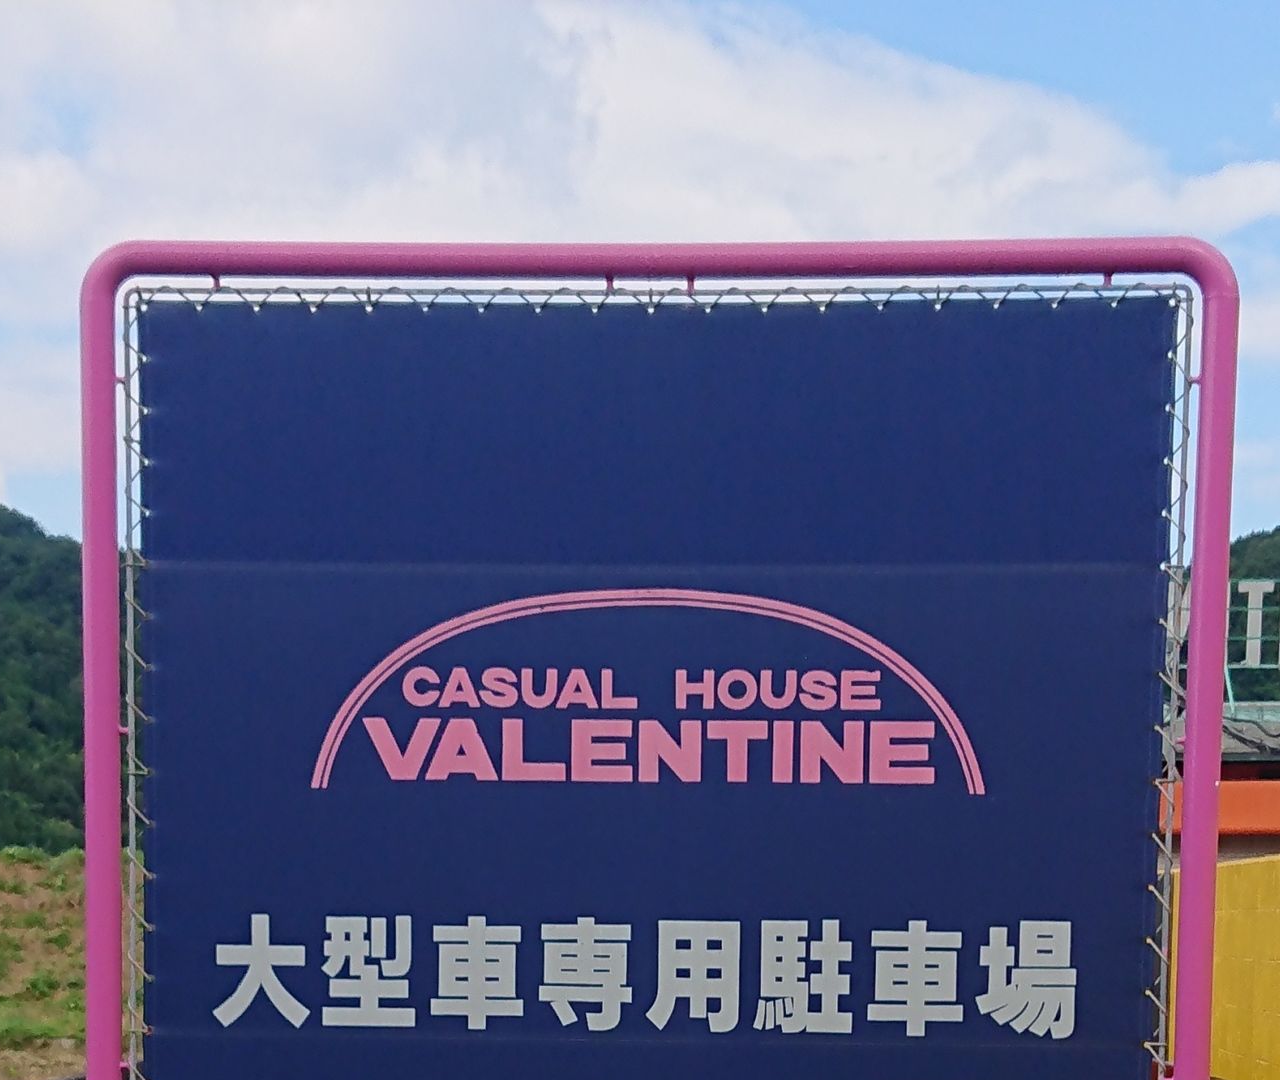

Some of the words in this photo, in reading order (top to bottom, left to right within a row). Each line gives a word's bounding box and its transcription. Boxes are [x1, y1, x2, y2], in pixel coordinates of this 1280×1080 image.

[401, 666, 638, 710] CASUAL
[674, 668, 882, 712] HOUSE
[362, 717, 936, 786] VALENTINE
[211, 912, 1078, 1040] 大型車専用駐車場
